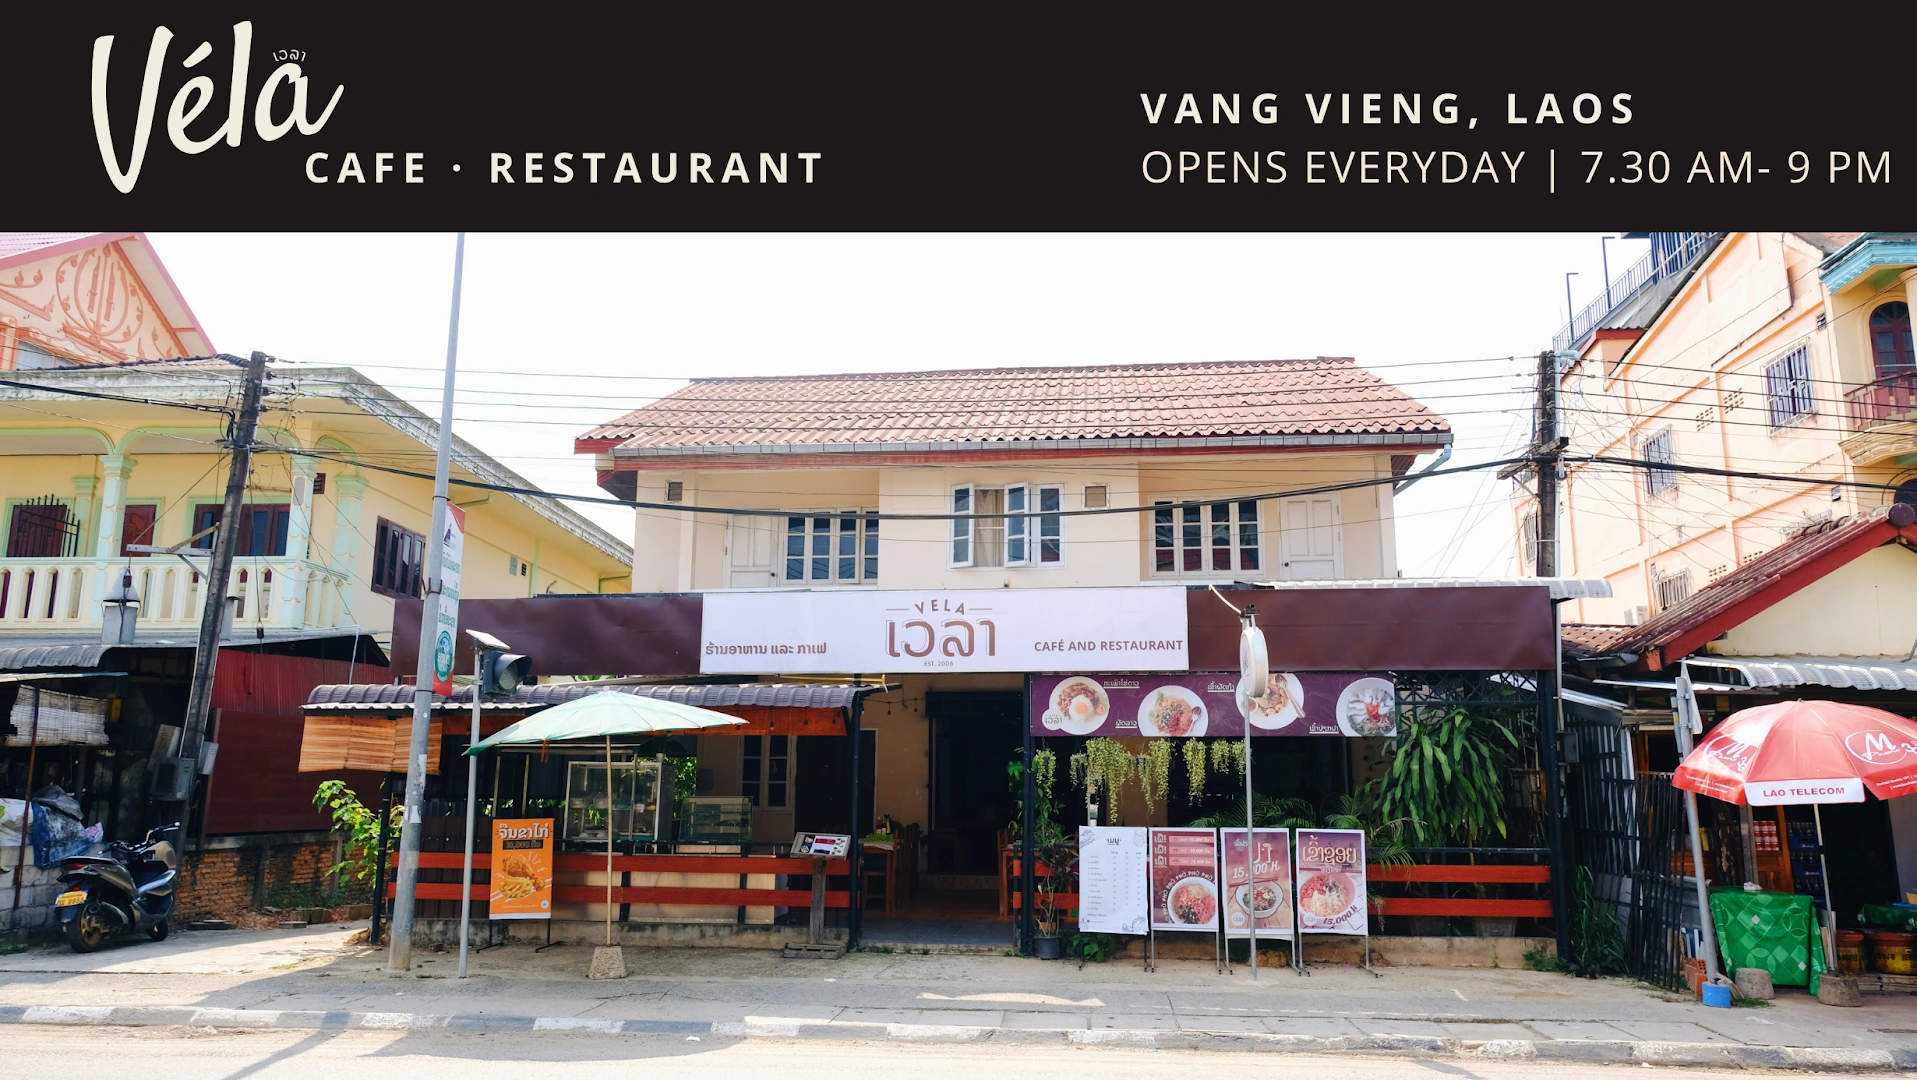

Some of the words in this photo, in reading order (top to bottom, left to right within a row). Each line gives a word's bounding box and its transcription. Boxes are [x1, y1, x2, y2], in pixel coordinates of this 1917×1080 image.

[914, 599, 965, 615] VELA
[887, 619, 996, 658] ເວລາ
[1034, 639, 1064, 651] CAFÉ
[1068, 641, 1096, 651] AND
[1100, 640, 1183, 651] RESTAURANT
[1763, 789, 1786, 797] LAO
[1789, 787, 1845, 796] TELECOM
[1323, 911, 1352, 925] 15,000
